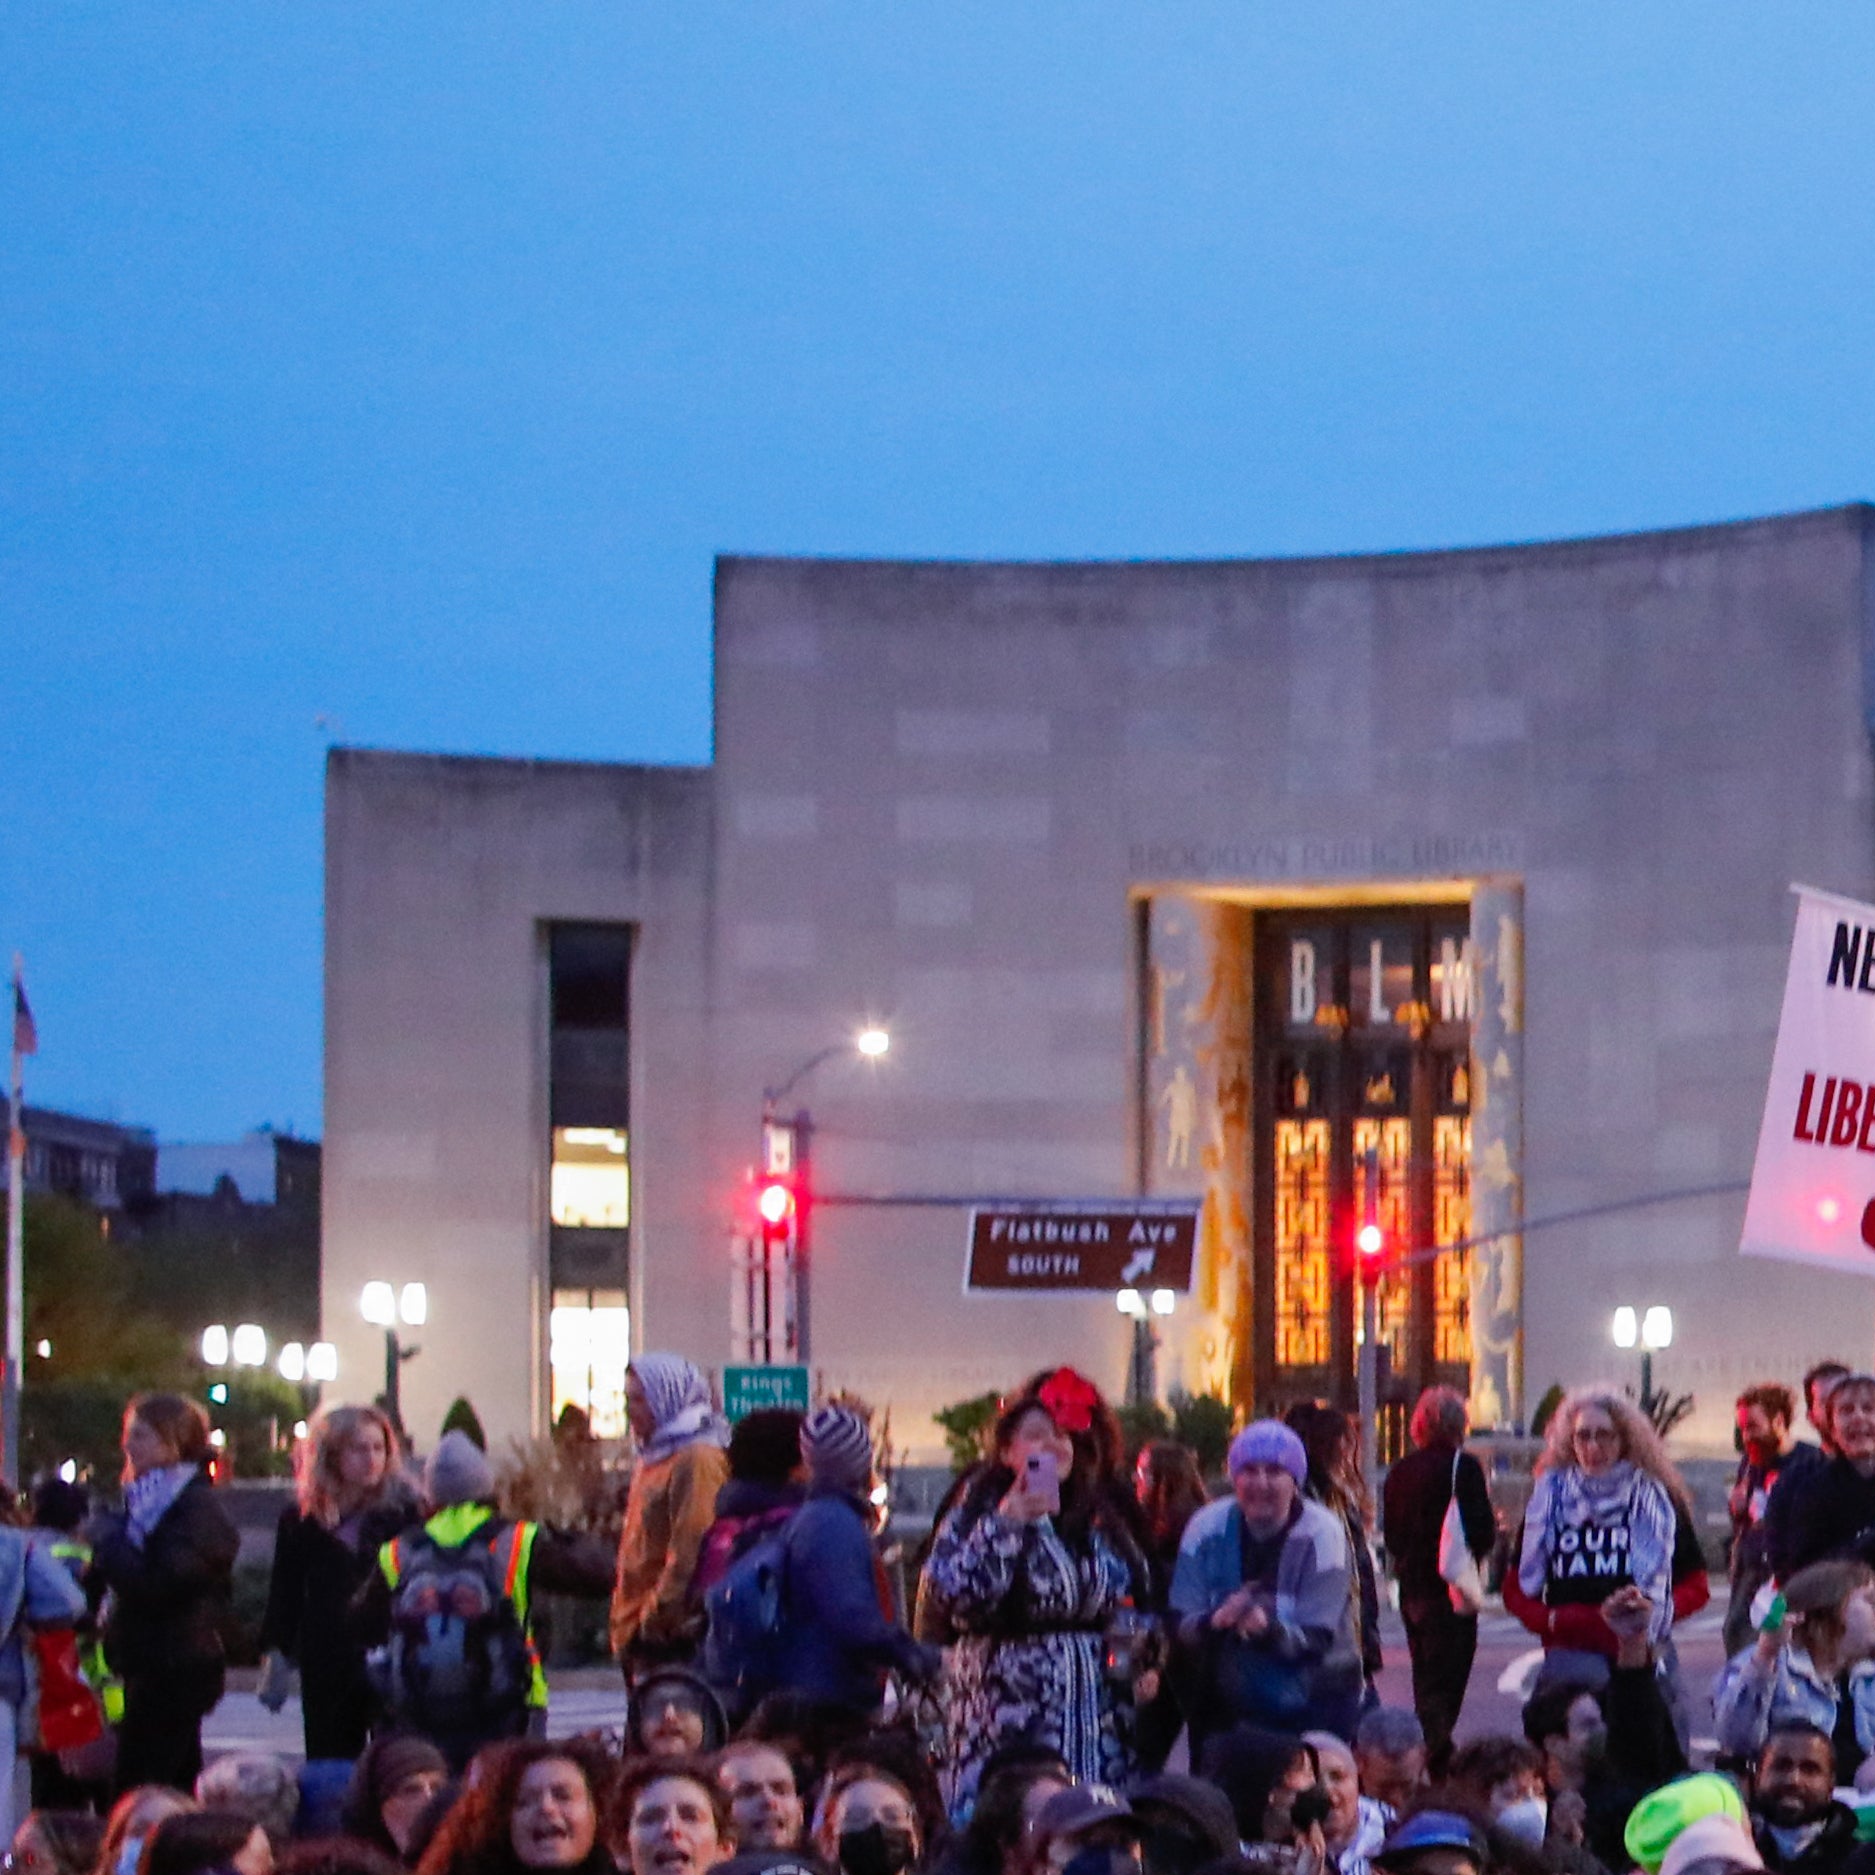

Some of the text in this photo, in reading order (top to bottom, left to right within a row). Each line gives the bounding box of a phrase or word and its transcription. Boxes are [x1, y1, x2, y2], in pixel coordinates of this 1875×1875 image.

[991, 1218, 1177, 1243] Flatbush Ave
[1007, 1254, 1080, 1277] SOUTH
